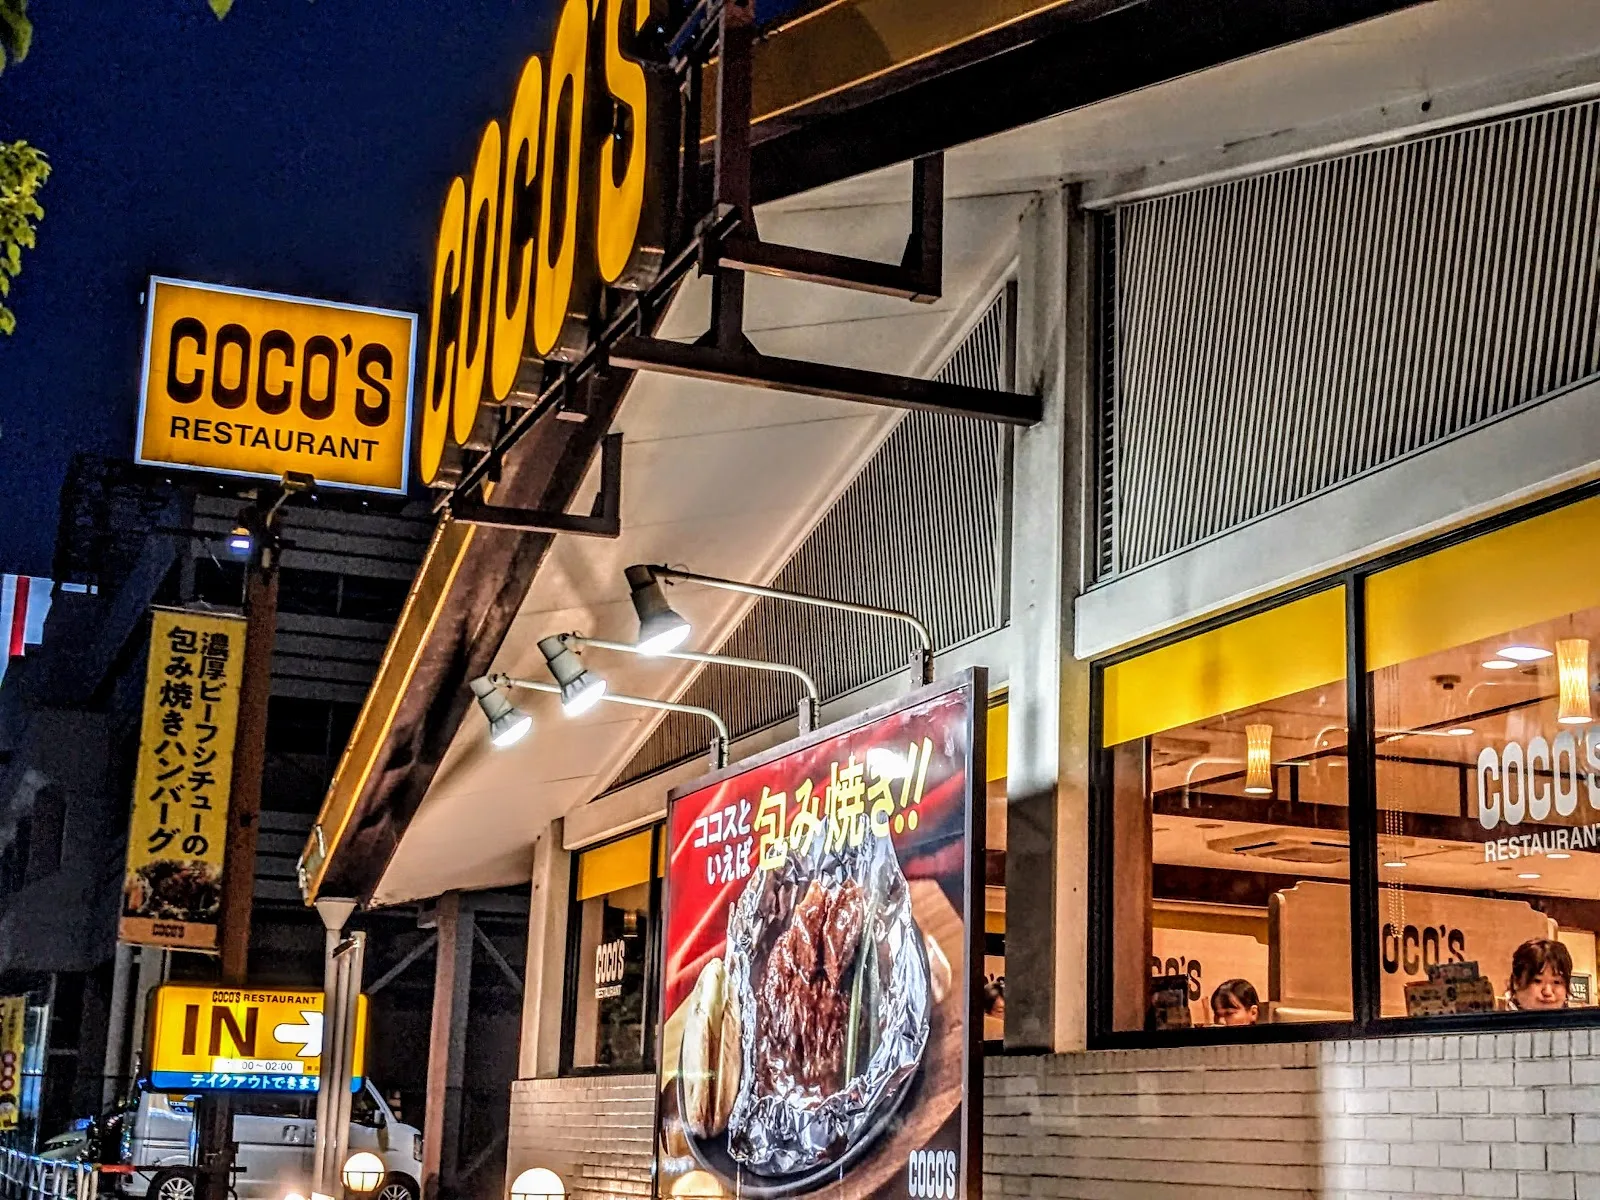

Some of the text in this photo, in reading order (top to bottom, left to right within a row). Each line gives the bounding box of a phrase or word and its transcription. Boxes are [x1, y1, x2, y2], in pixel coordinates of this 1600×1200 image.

[420, 0, 650, 485] COCOS
[166, 317, 393, 427] COCO'S
[169, 416, 380, 462] RESTAURANT
[147, 625, 197, 853] 包み焼きハンバーグ
[182, 632, 229, 856] 濃厚ビーフシチューの
[694, 798, 751, 848] ココスと
[707, 835, 754, 885] いえば
[595, 938, 625, 984] COCO'S
[1382, 922, 1465, 976] OCO'S
[212, 990, 317, 1005] COCO'S RESTAURANT
[181, 1004, 259, 1057] IN
[908, 1149, 956, 1200] COCO'S
